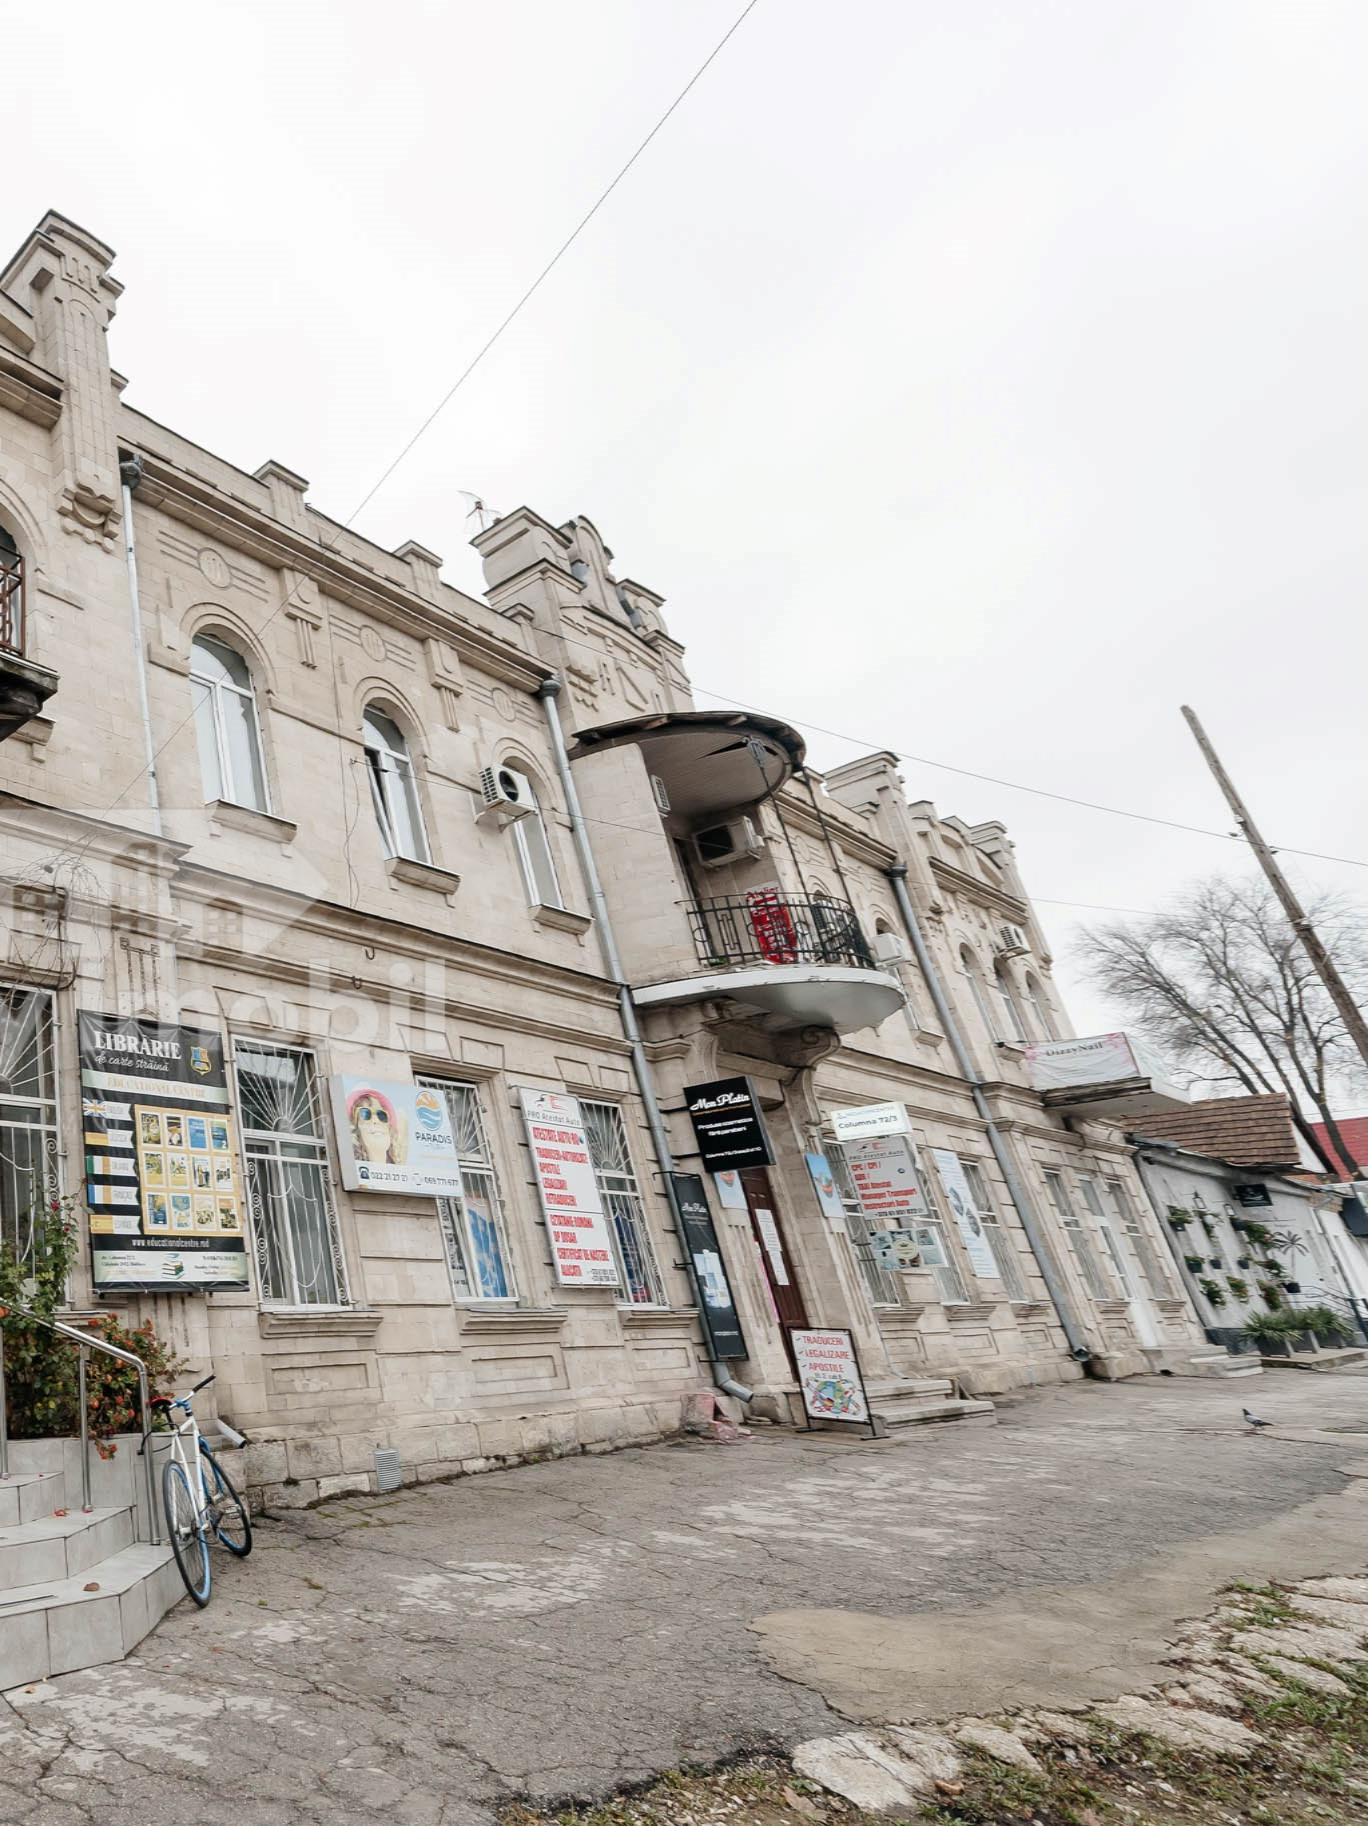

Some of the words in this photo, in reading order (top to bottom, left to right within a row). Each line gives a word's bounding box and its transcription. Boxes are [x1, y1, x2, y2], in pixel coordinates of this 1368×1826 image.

[94, 1031, 181, 1060] LIBRĂRIE
[95, 1052, 107, 1064] de
[109, 1056, 134, 1068] carte
[838, 1119, 877, 1129] Columna
[879, 1115, 898, 1124] 72/3
[415, 1132, 453, 1144] PARADIS
[802, 1336, 843, 1346] TRADUCERI
[805, 1349, 850, 1360] LEGALIZARE
[809, 1362, 844, 1373] APOSTILE
